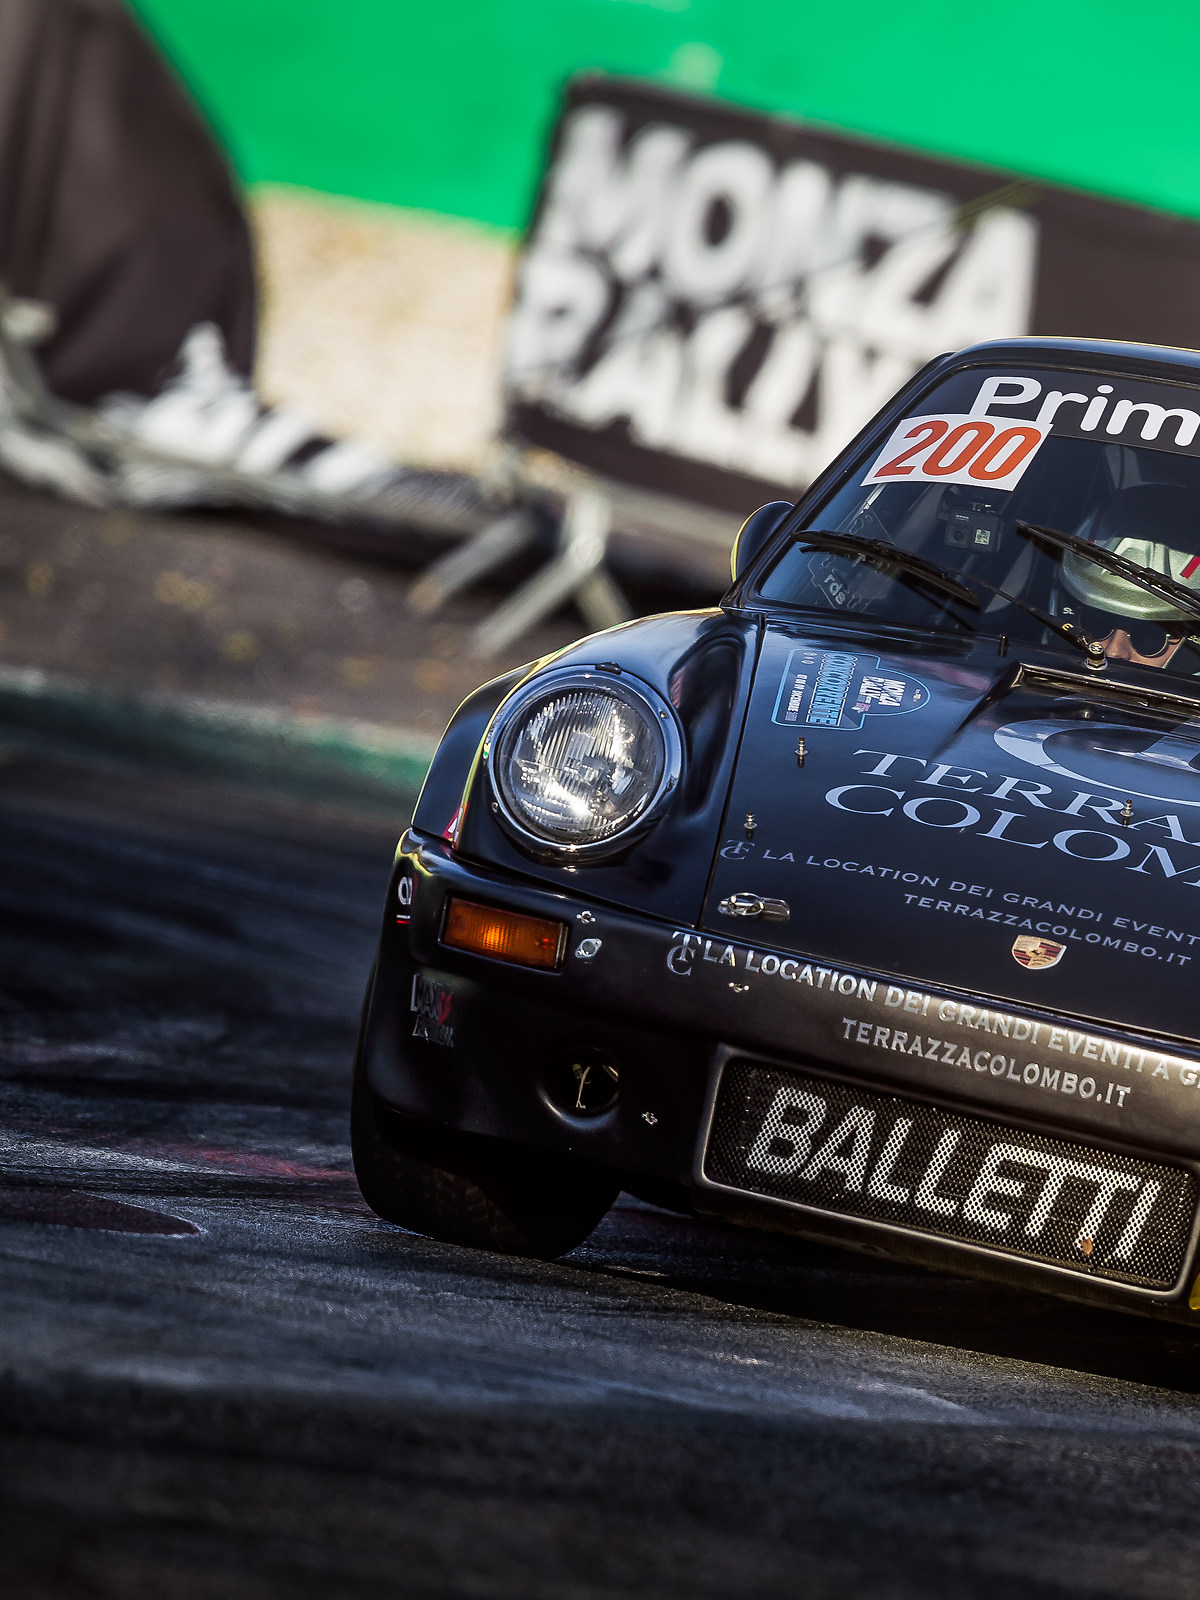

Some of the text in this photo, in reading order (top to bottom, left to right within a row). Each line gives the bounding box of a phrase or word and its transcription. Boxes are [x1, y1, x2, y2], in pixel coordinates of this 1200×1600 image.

[548, 103, 1039, 350] MONZA
[873, 420, 1042, 481] 200
[806, 652, 859, 727] CONCORRENTE
[762, 848, 796, 863] LA
[805, 855, 941, 888] LOCATION
[948, 880, 994, 899] DEI
[1002, 891, 1104, 922] GRANDI
[902, 893, 1193, 967] TERRAZZACOLOMBO.IT
[703, 938, 736, 967] LA
[744, 949, 879, 1002] LOCATION
[883, 985, 932, 1017] DEI
[937, 999, 1040, 1045] GRANDI
[1047, 1028, 1147, 1074] EVENTI
[1151, 1059, 1171, 1081] A
[841, 1016, 1132, 1109] TERRAZZACOLOMBO.IT
[746, 1086, 1162, 1264] BALLETTI
